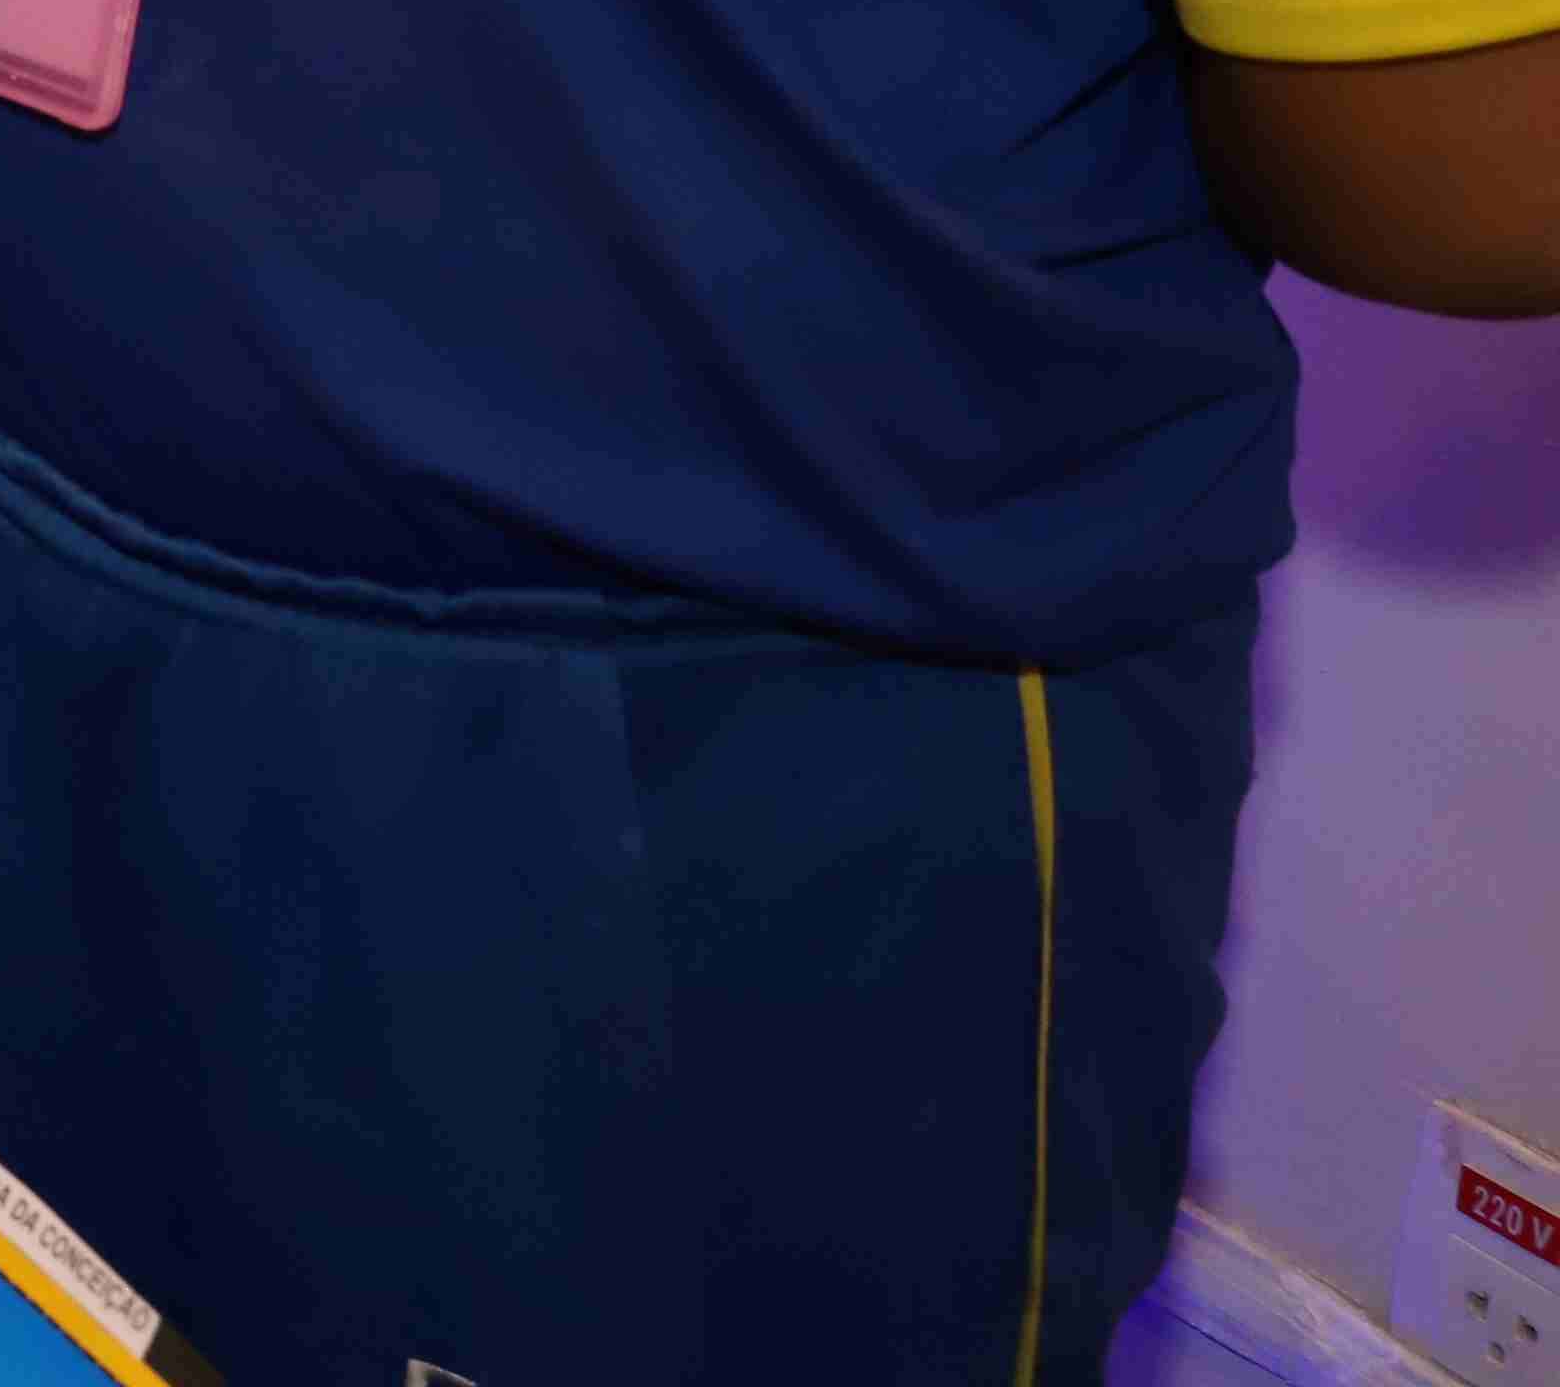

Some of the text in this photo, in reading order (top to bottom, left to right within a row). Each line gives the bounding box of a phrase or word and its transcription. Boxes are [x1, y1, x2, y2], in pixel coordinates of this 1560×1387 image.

[11, 1198, 41, 1234] DA
[39, 1225, 153, 1334] CONCEIÇÃO
[1471, 1185, 1553, 1250] 220 V
